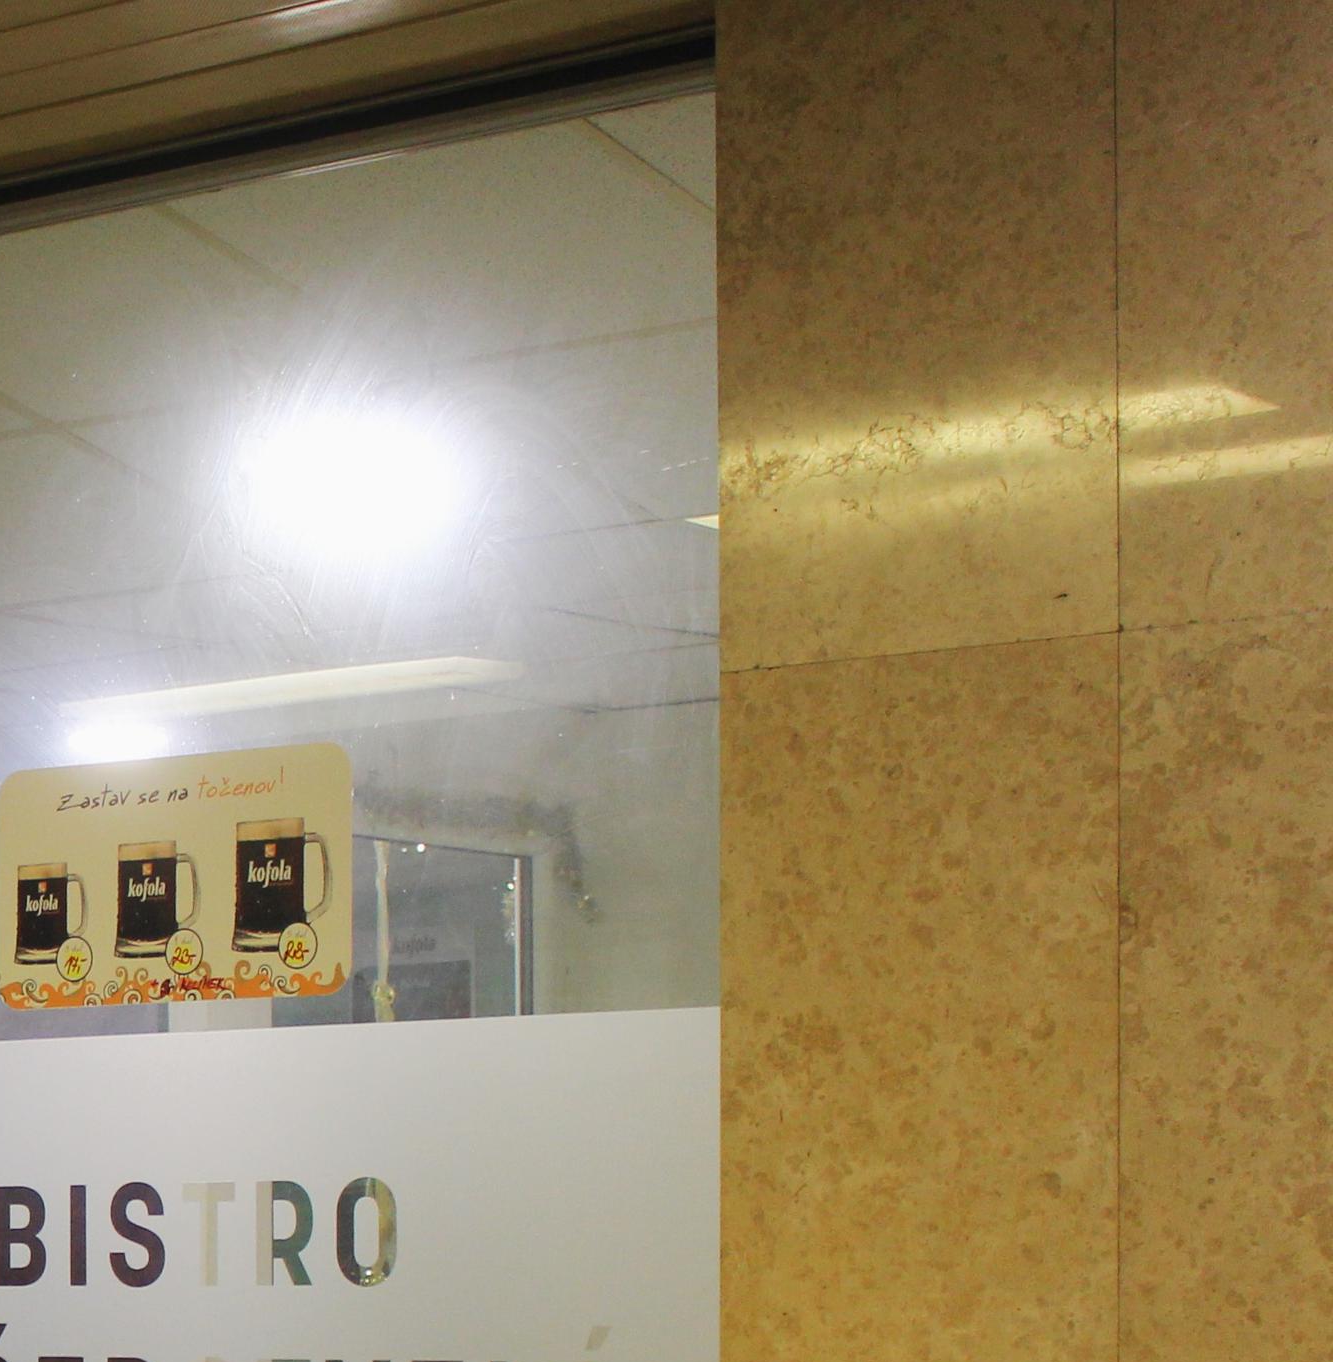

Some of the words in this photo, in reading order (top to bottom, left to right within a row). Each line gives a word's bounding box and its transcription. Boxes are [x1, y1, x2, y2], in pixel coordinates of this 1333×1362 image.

[57, 784, 131, 812] Zastav
[137, 789, 160, 804] se
[167, 787, 188, 803] na
[247, 858, 292, 888] kofola
[128, 876, 165, 902] kofola
[26, 895, 58, 917] kofola
